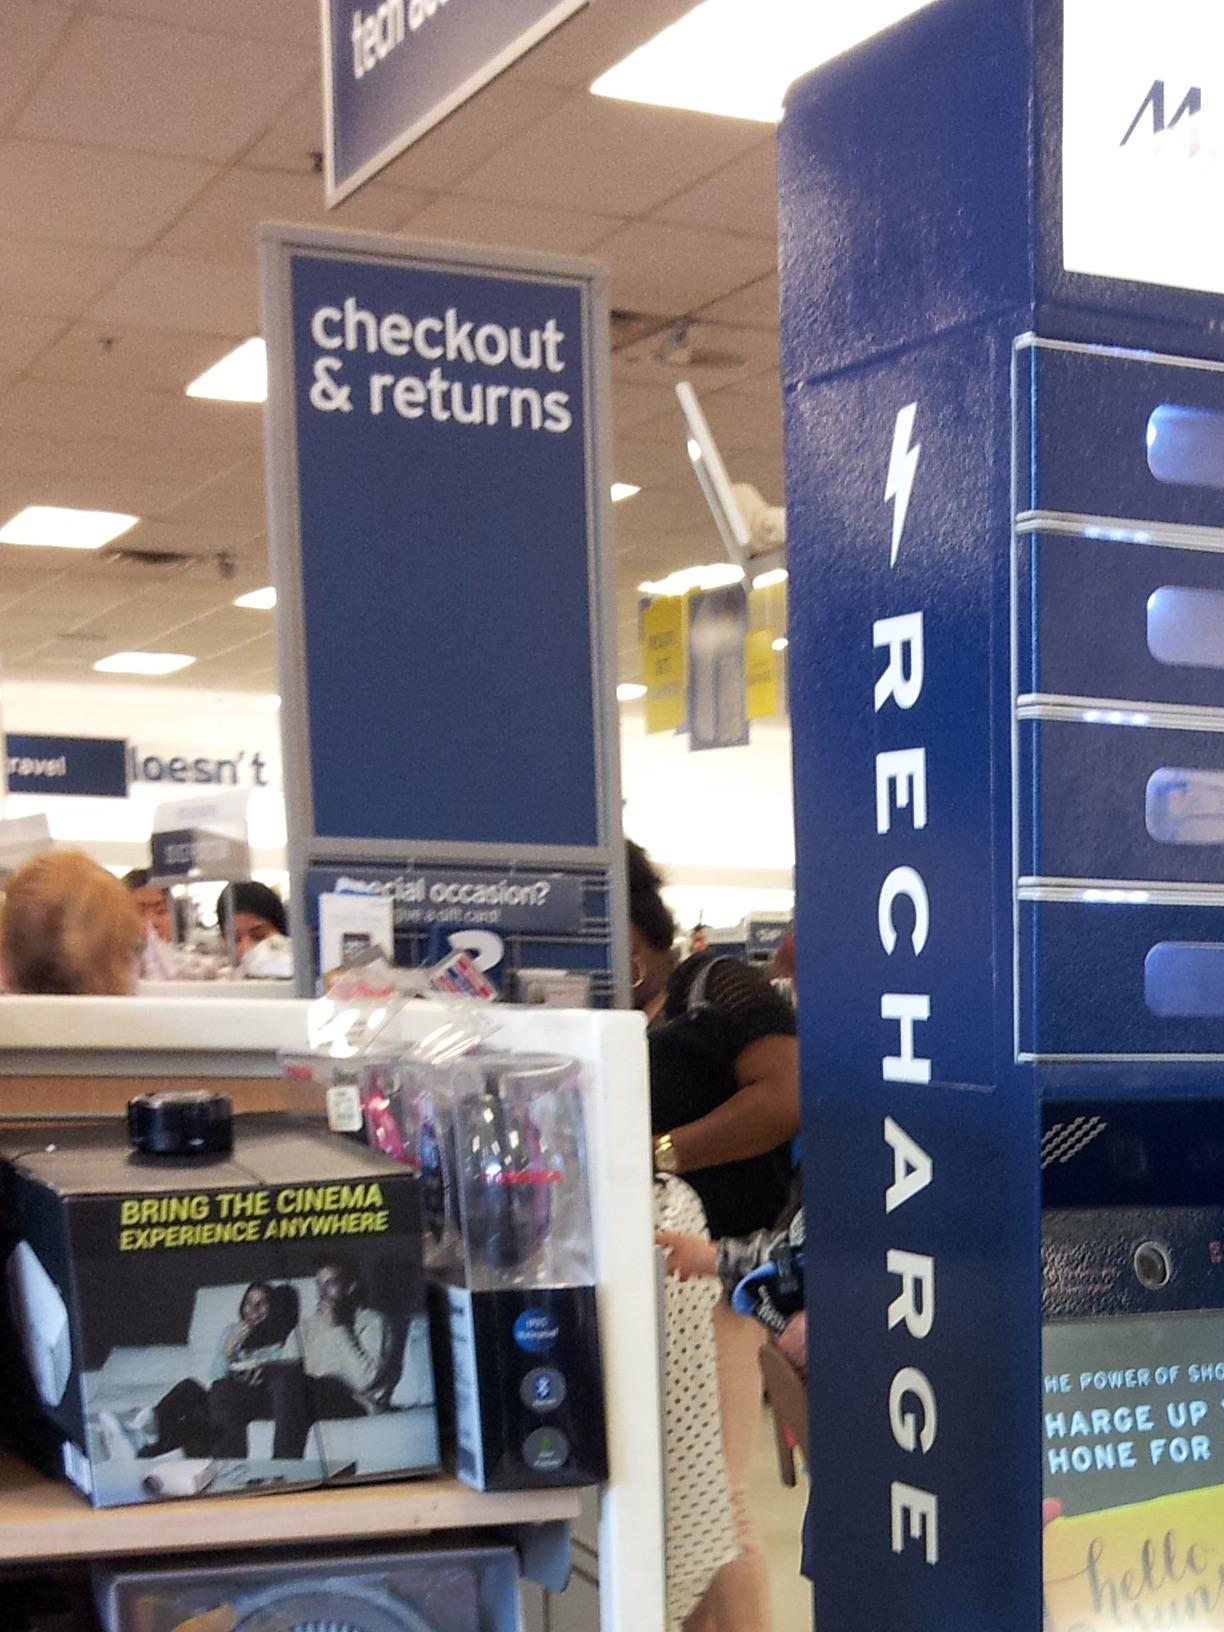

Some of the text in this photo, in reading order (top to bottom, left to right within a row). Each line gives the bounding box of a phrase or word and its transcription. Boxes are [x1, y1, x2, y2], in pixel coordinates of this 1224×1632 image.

[310, 297, 566, 374] checkout
[309, 358, 573, 434] & returns
[7, 755, 67, 777] ravel
[429, 878, 551, 906] occasion?
[872, 610, 940, 1566] RECHARGE
[120, 1183, 384, 1226] BRING THE CINEMA
[120, 1210, 390, 1251] EXPERIENCE ANYWHERE
[1044, 1373, 1073, 1394] HE
[1079, 1368, 1150, 1391] POWER
[1154, 1365, 1181, 1385] OF
[1044, 1405, 1155, 1439] HARGE
[1166, 1400, 1208, 1429] UP
[1047, 1441, 1137, 1475] HONE
[1150, 1434, 1212, 1466] FOR
[1044, 1529, 1208, 1626] hello
